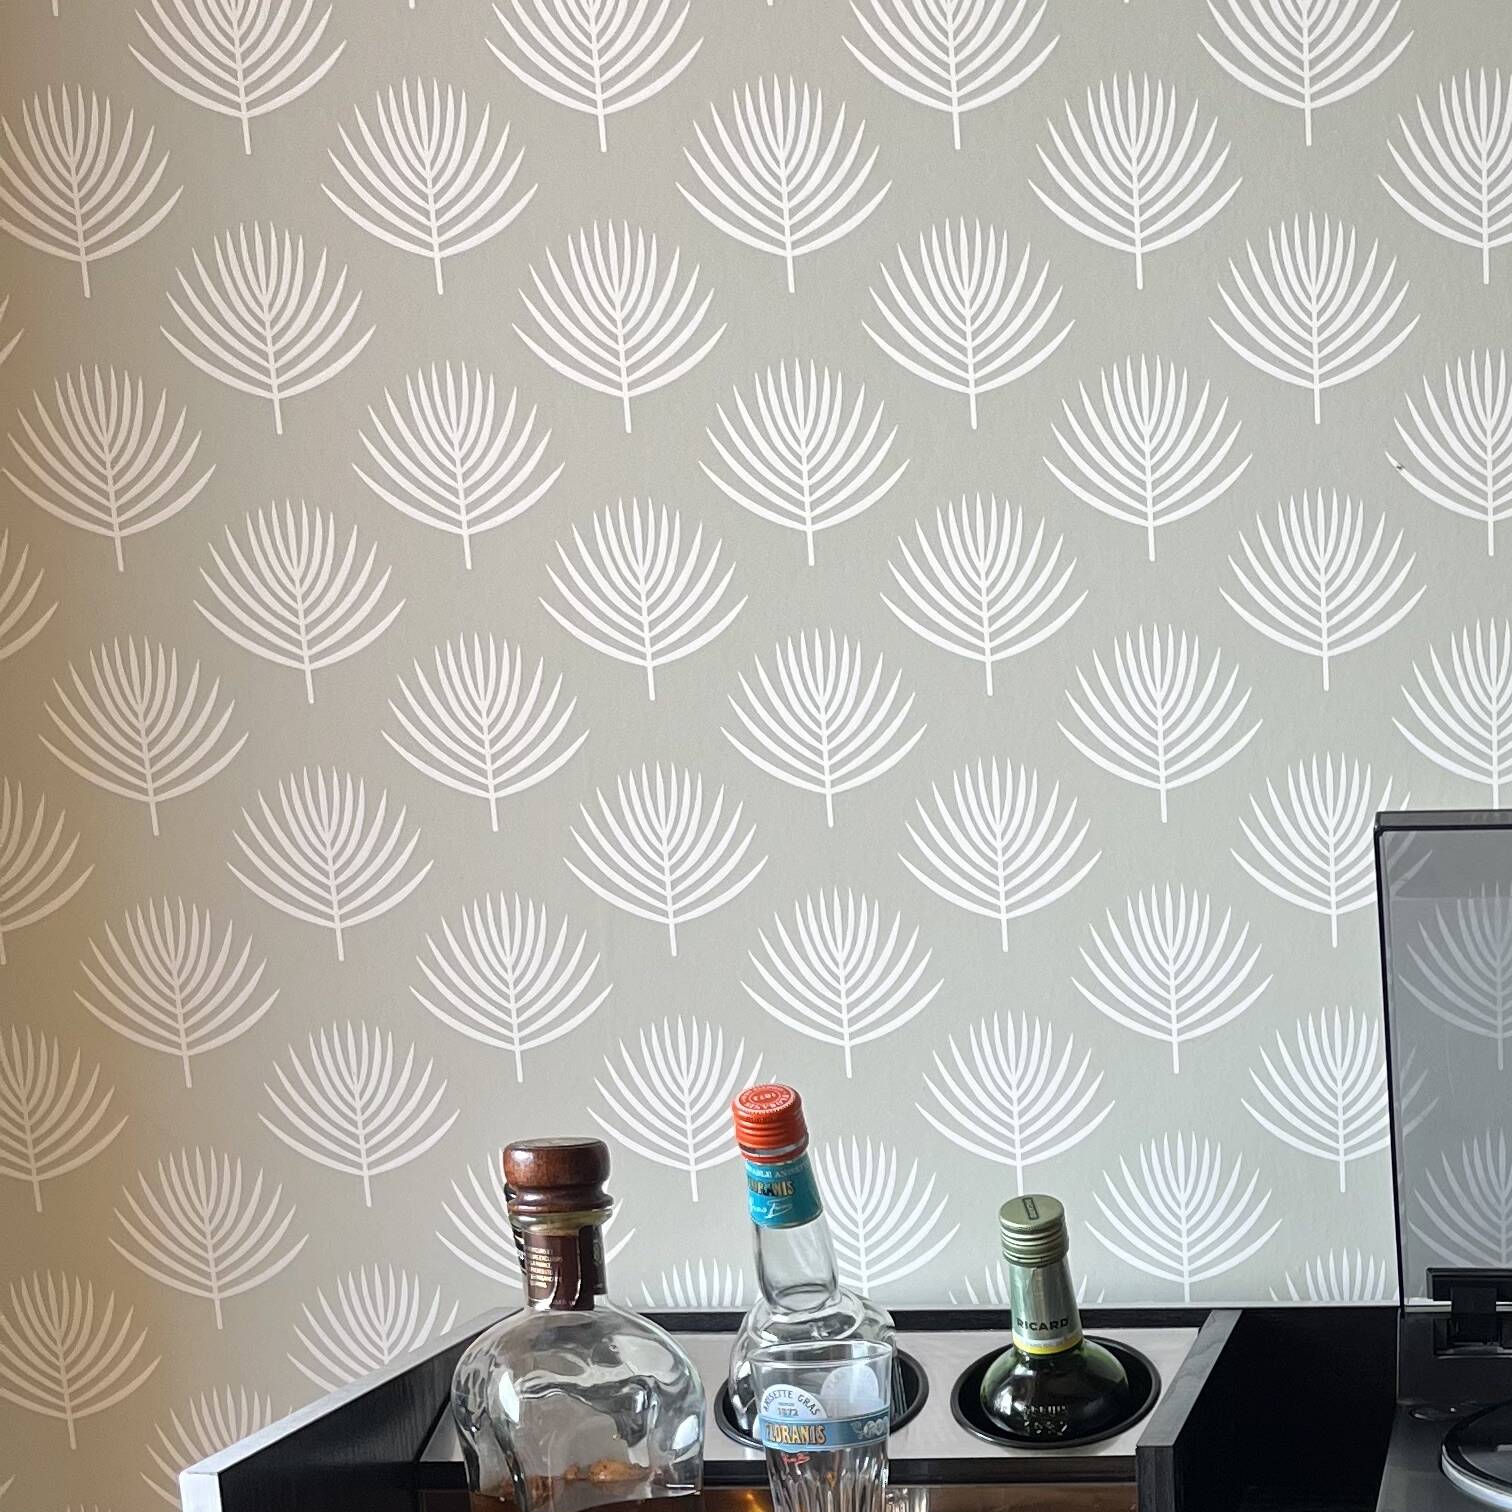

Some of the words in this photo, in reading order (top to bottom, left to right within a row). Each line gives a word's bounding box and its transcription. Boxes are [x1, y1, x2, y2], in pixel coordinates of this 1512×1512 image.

[1016, 1317, 1069, 1331] RICARD
[763, 1389, 793, 1412] ANISETTE
[797, 1393, 820, 1416] GRAS
